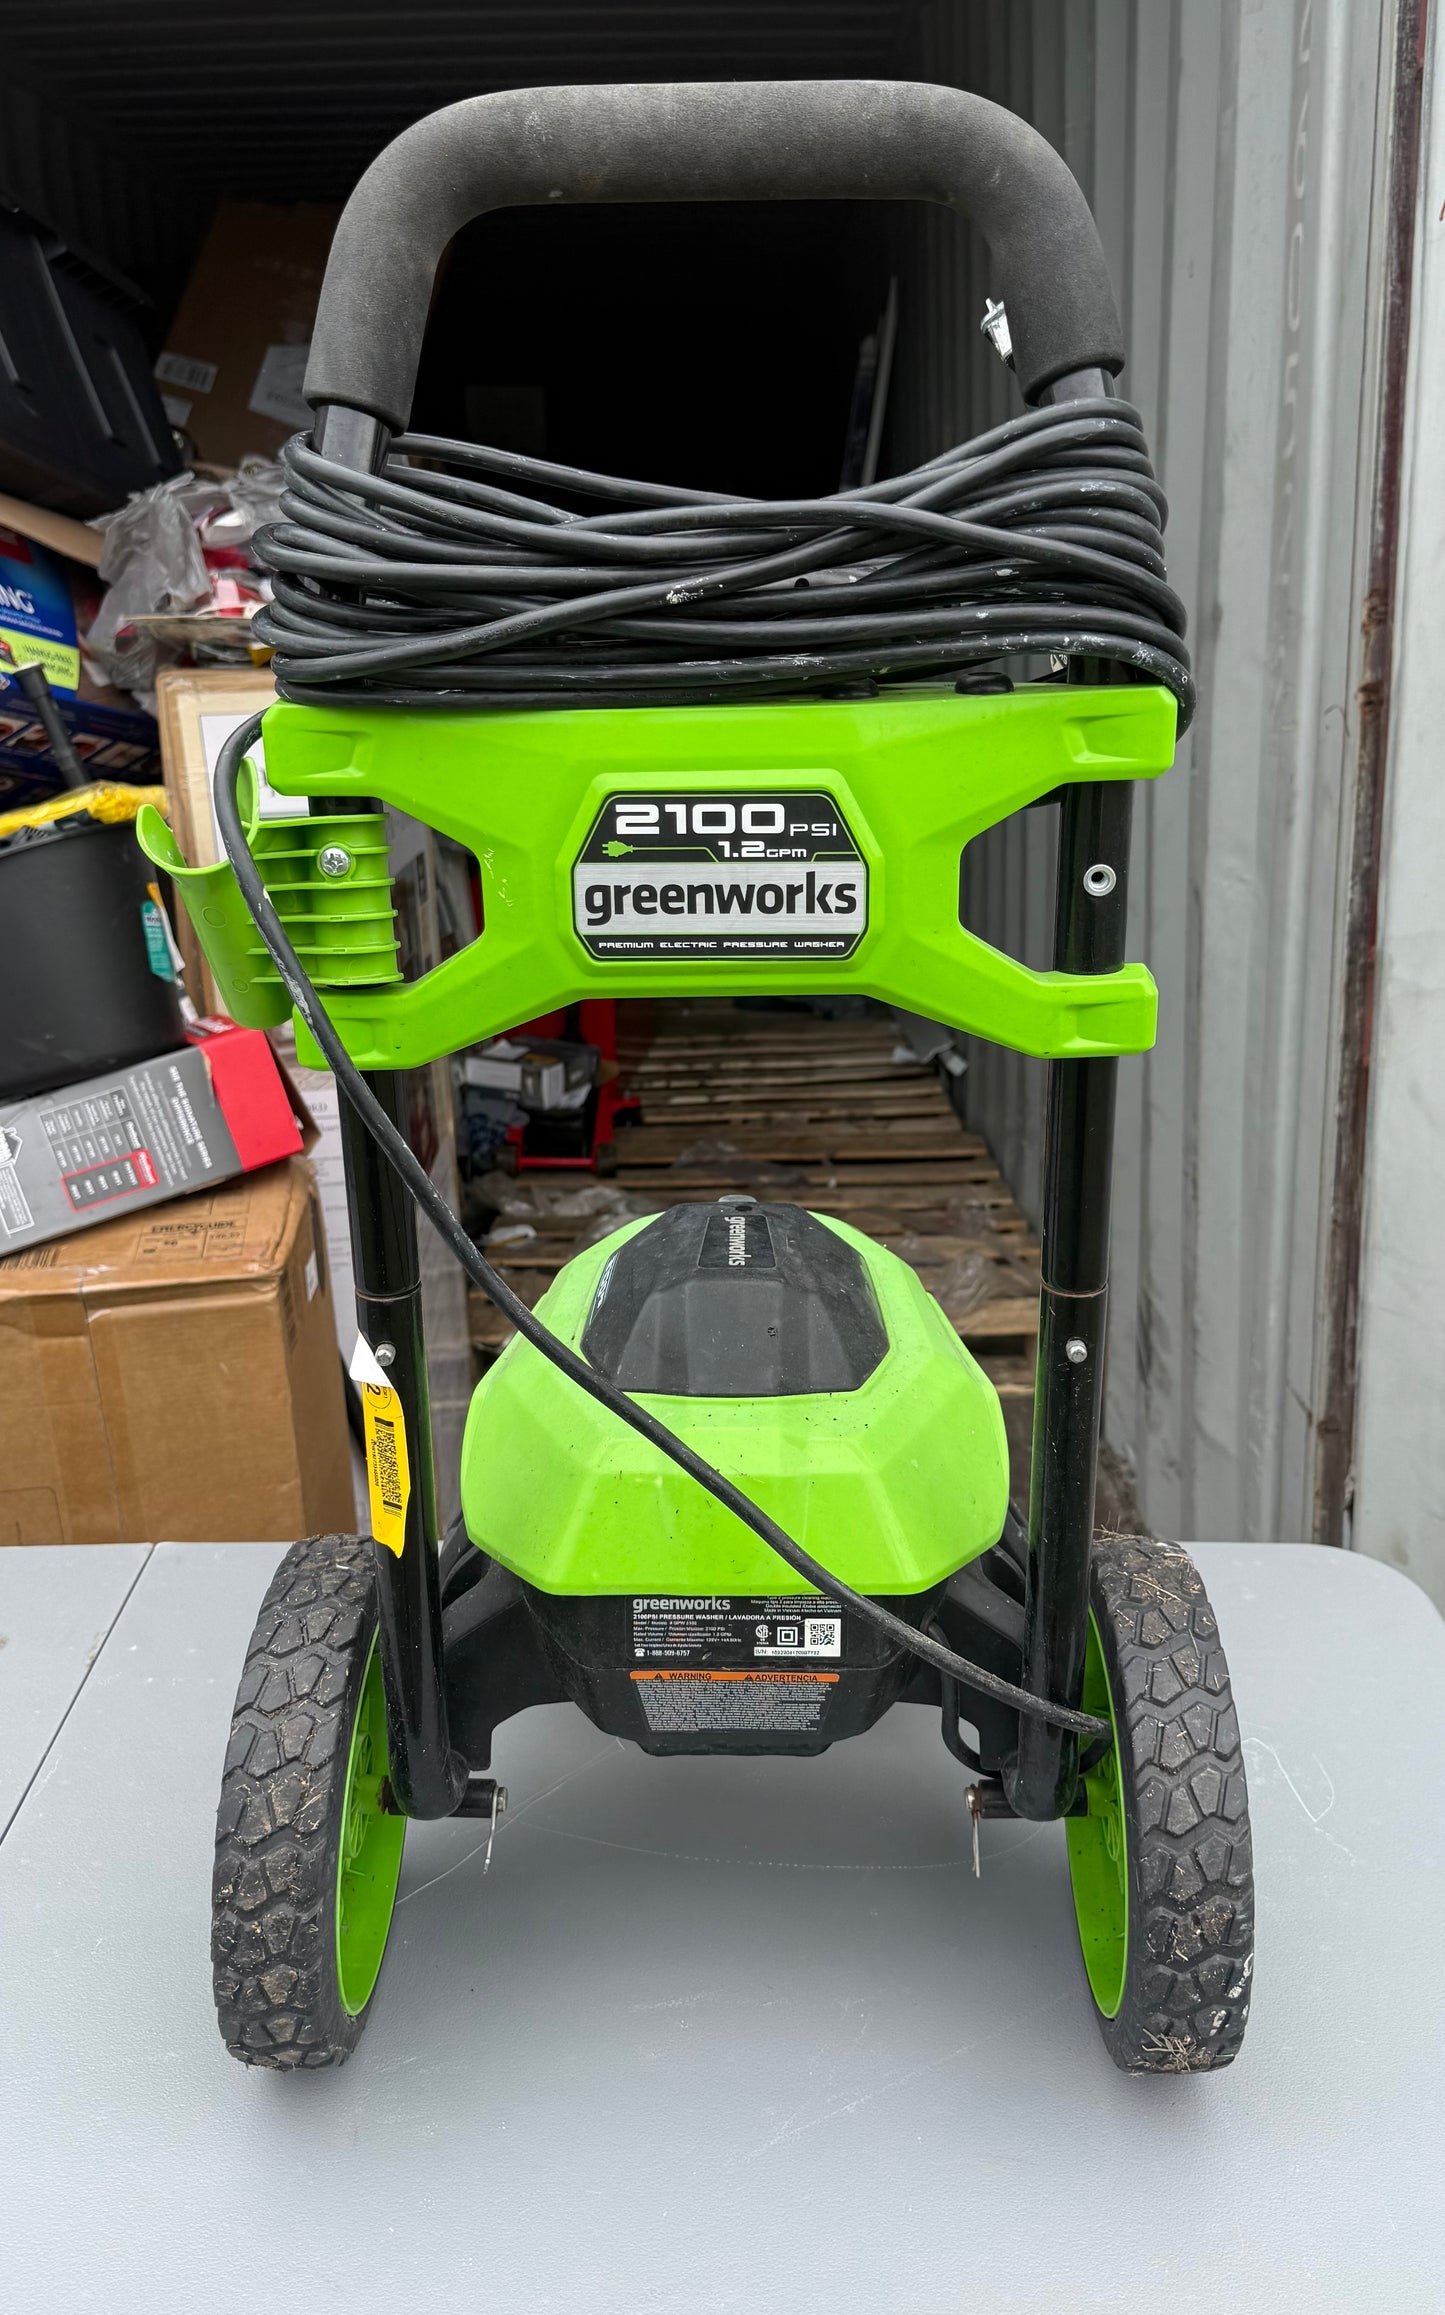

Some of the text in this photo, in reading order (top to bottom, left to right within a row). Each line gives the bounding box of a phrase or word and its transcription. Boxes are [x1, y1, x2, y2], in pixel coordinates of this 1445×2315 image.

[615, 803, 837, 837] 2100 PSI
[718, 840, 807, 858] 1.2 GPM
[585, 870, 858, 926] greenworks
[598, 941, 654, 949] PREMIUM
[725, 1217, 751, 1266] greenworks
[632, 1596, 731, 1613] greenworks
[668, 1672, 712, 1680] WARNING
[755, 1674, 818, 1682] ADVERTENCIA
